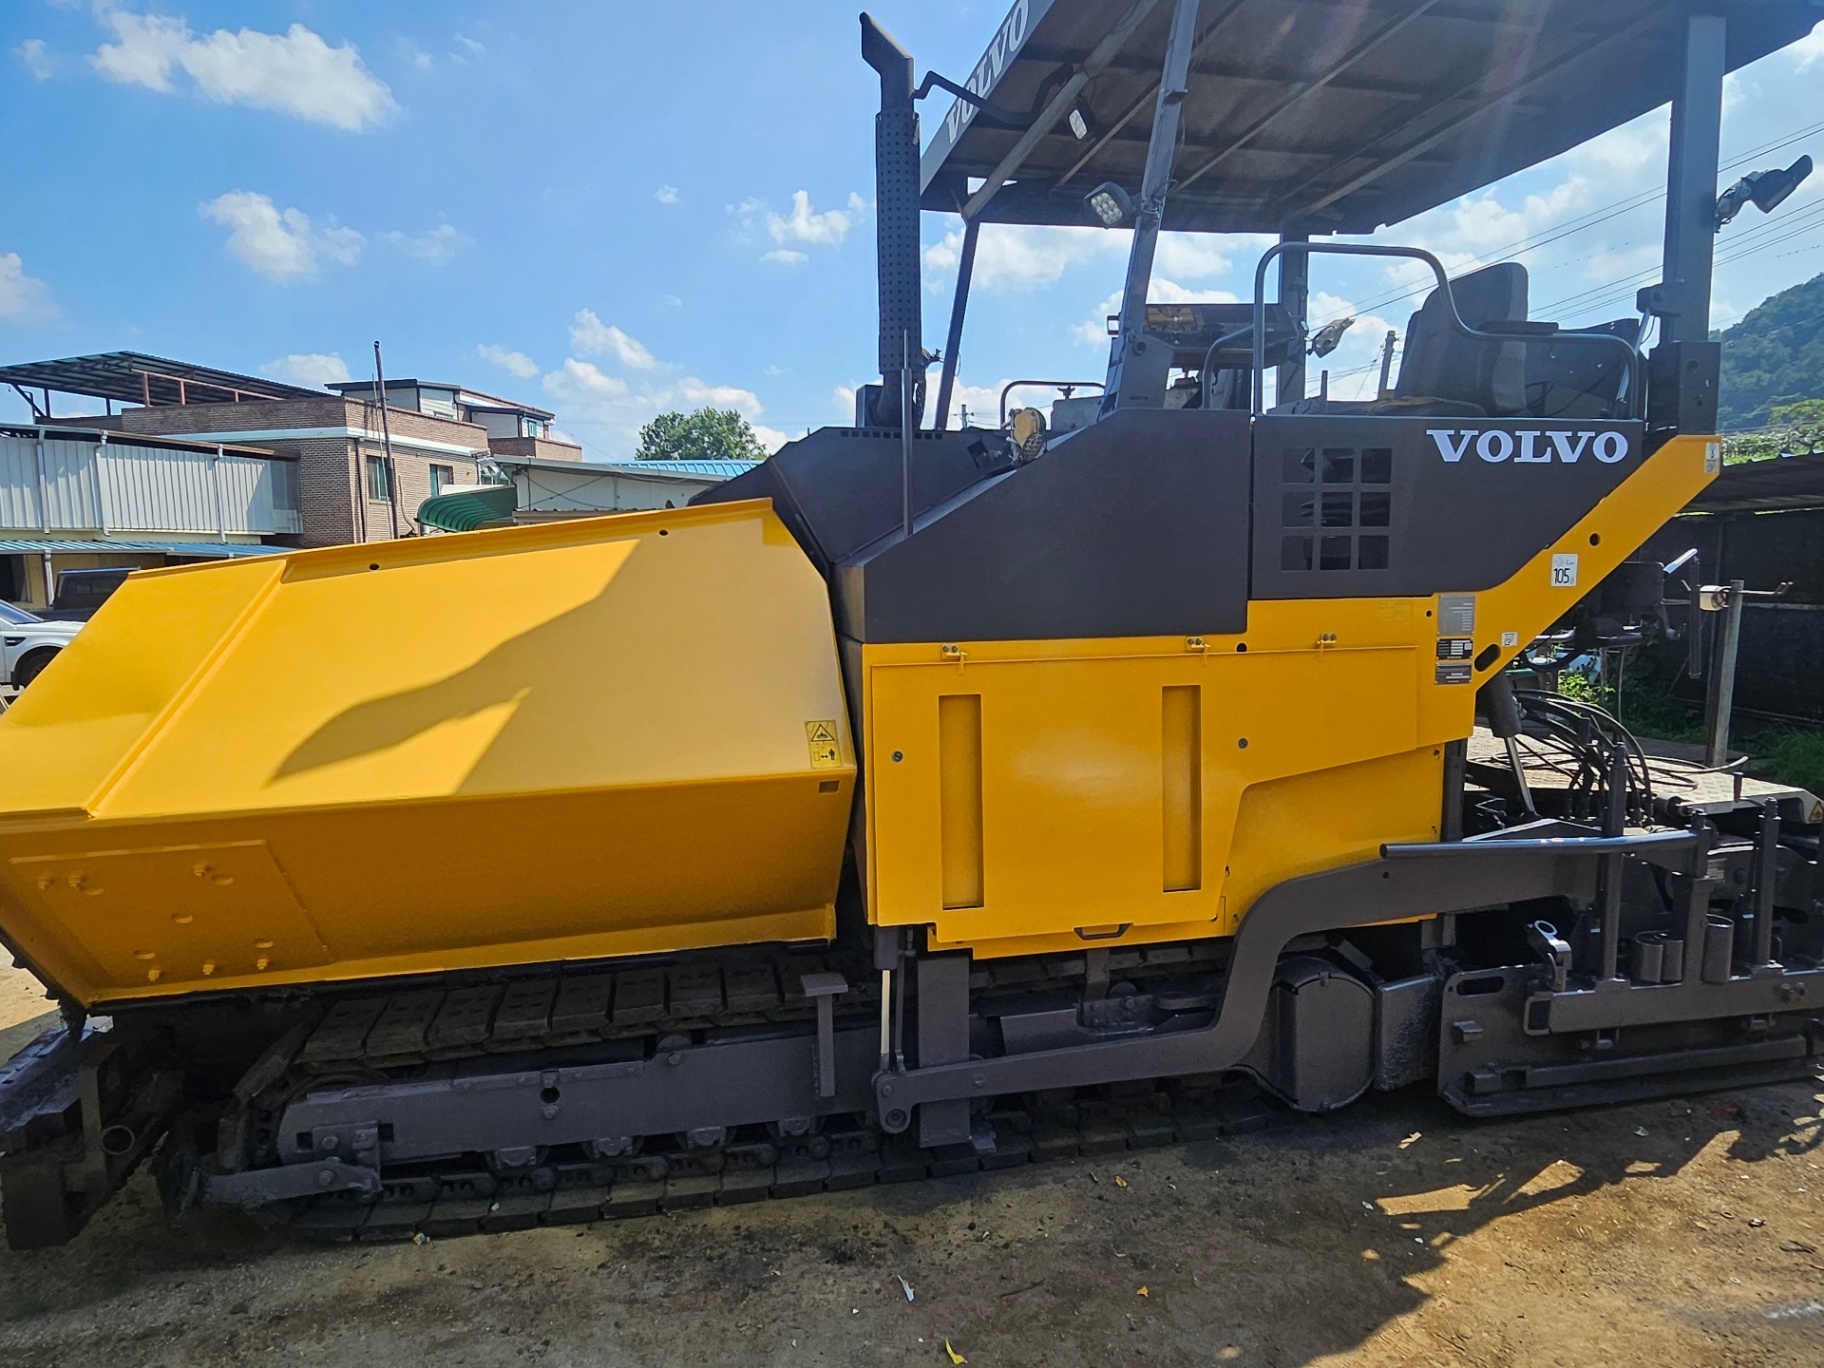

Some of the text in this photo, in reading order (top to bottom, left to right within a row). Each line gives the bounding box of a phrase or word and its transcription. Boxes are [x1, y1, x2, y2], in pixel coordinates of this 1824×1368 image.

[946, 0, 1029, 144] VOLVO
[1426, 429, 1629, 464] VOLVO
[1553, 567, 1571, 585] 105
